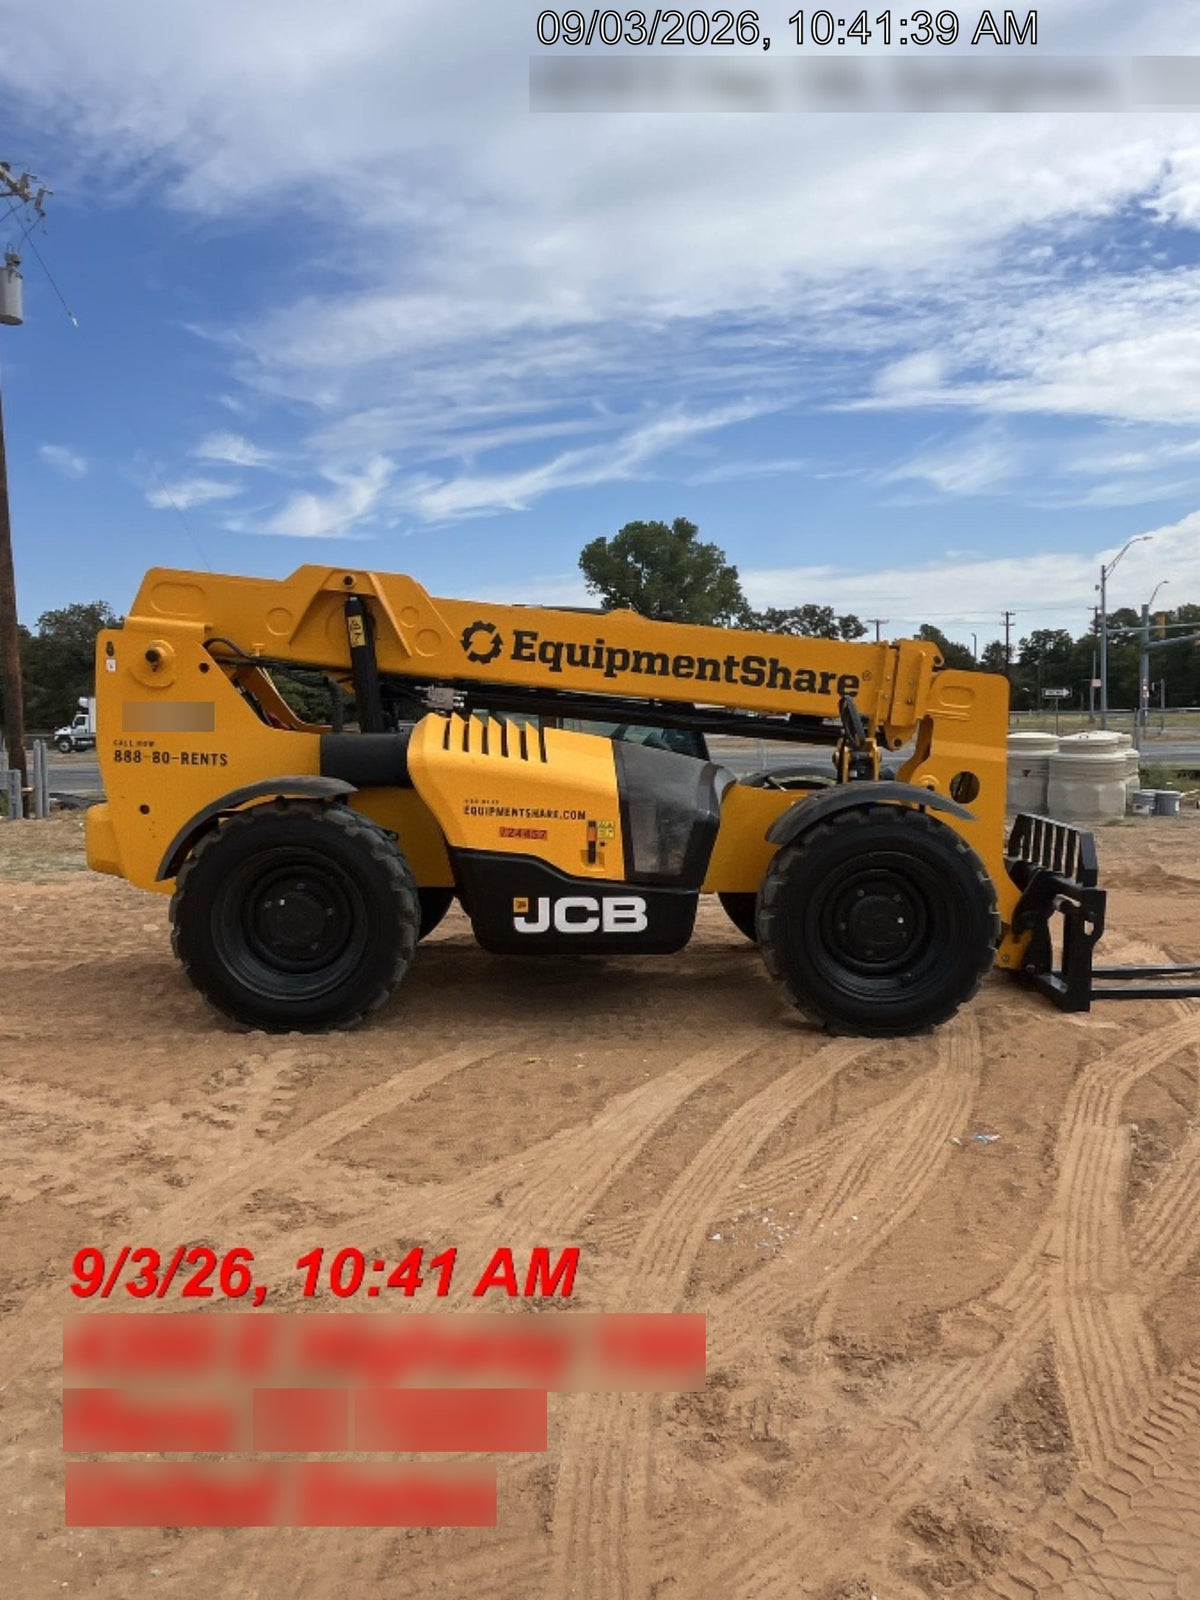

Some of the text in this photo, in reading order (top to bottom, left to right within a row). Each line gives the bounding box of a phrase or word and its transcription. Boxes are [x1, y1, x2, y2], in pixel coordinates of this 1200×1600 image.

[113, 749, 229, 767] 888-80-RENTS
[464, 805, 587, 820] EQUIPMENTSHARE.COM
[513, 897, 648, 933] JCB
